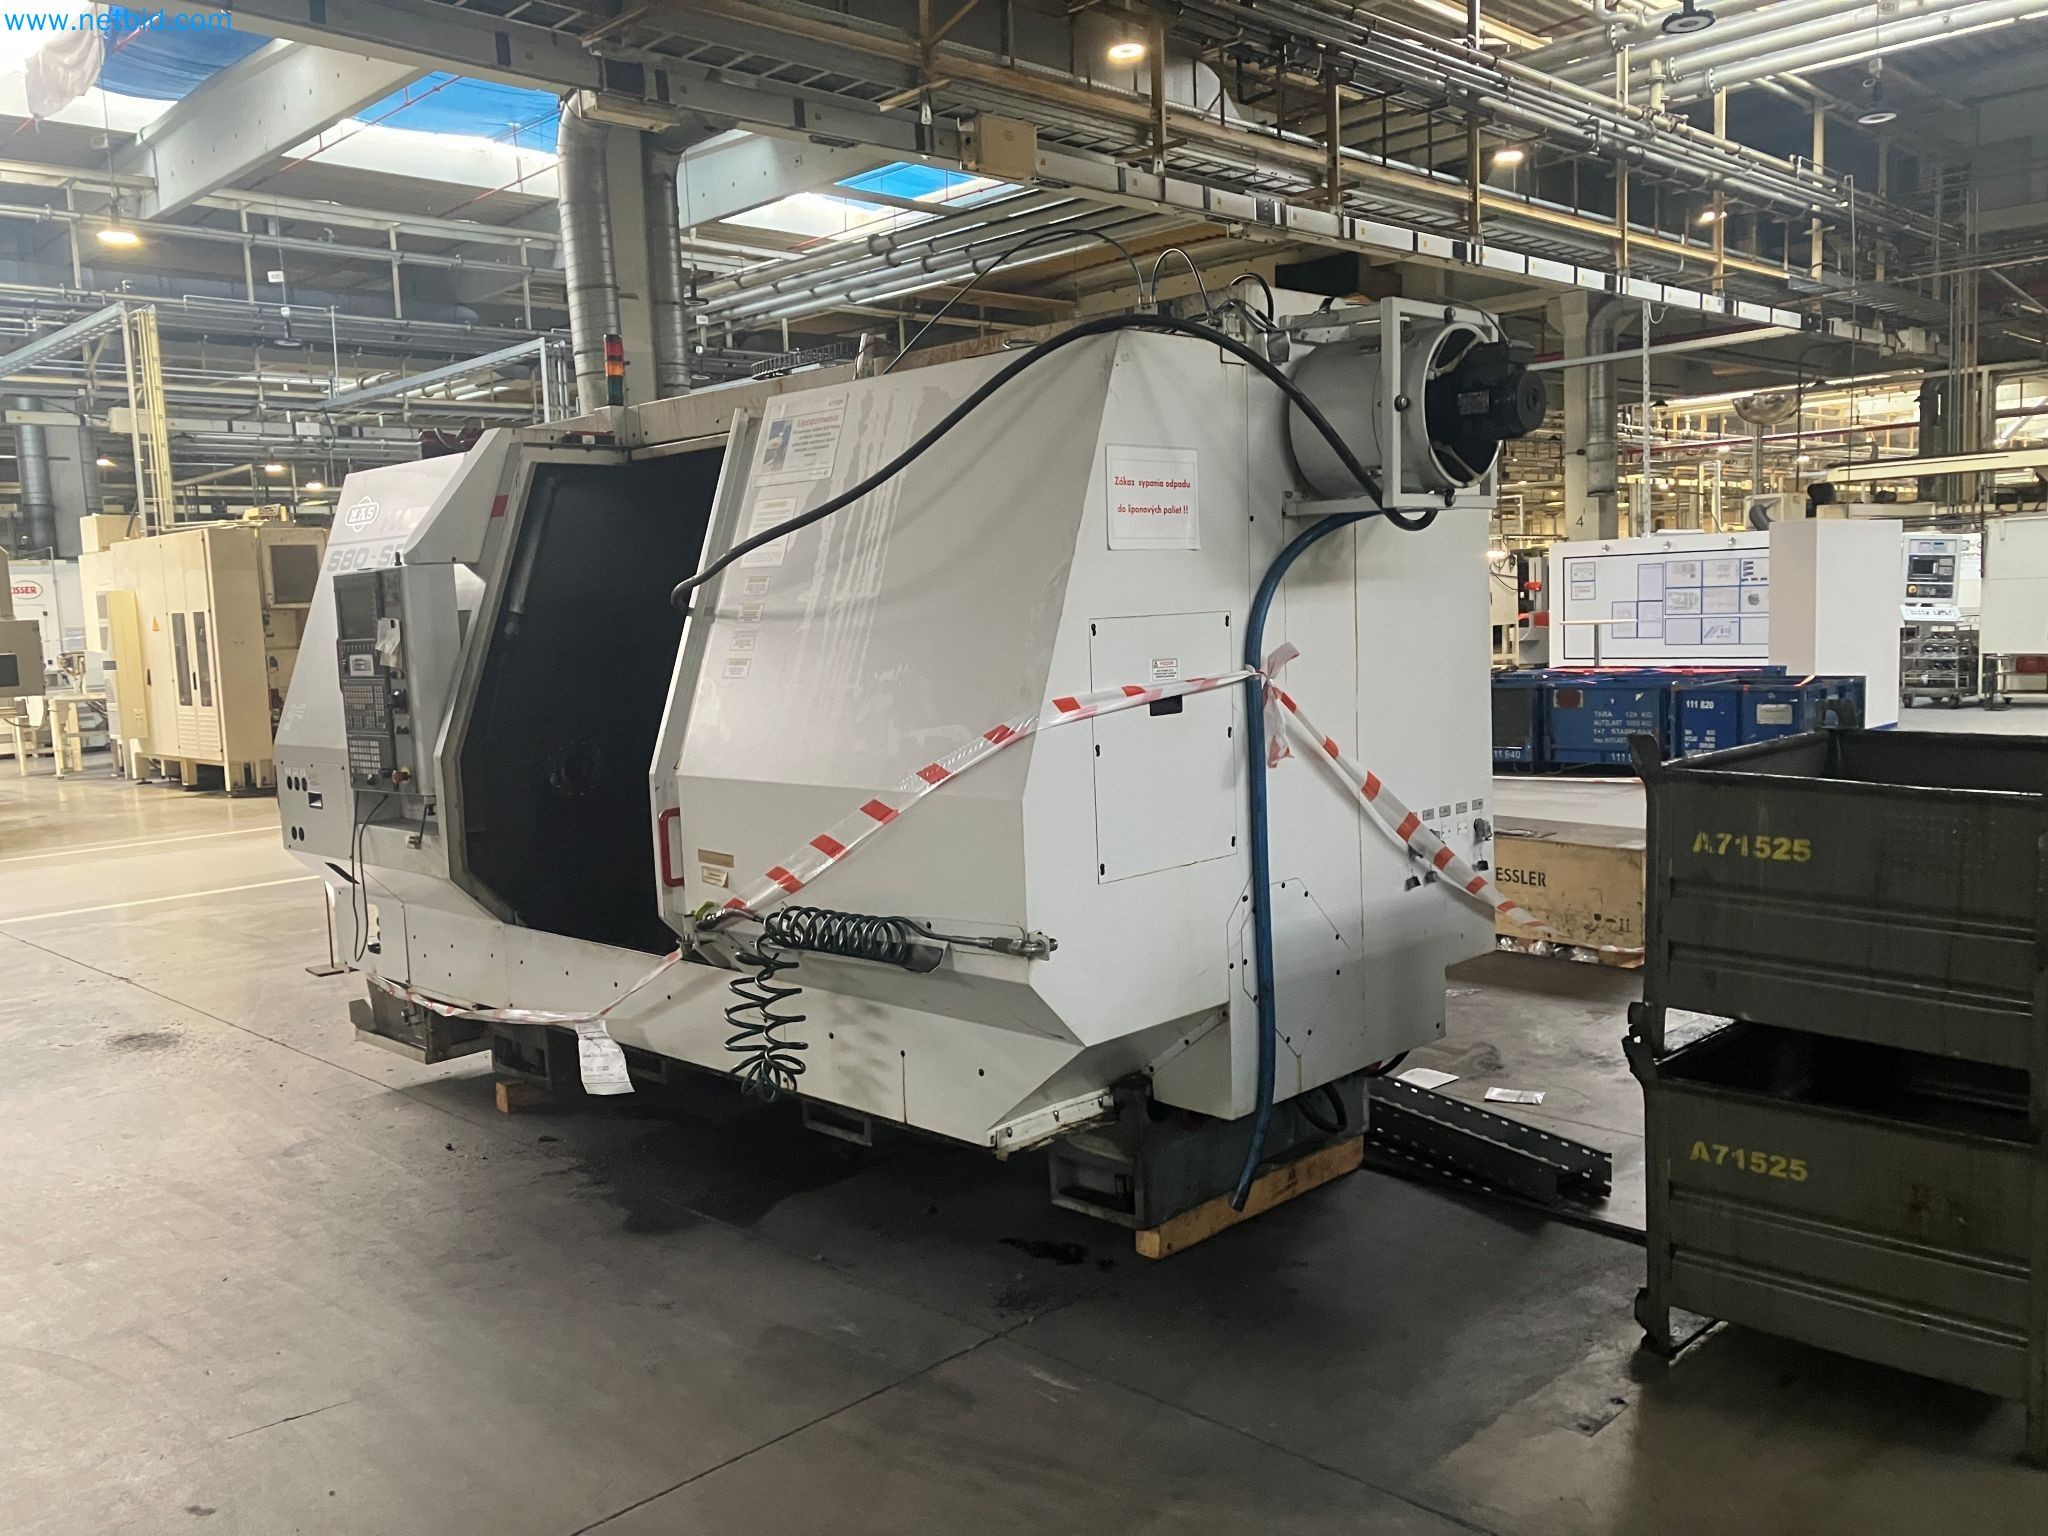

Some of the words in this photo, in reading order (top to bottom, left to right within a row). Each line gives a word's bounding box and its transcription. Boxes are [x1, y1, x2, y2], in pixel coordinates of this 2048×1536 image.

[1165, 478, 1191, 490] odpadu
[1118, 504, 1126, 513] do
[1576, 515, 1584, 527] 4
[1691, 831, 1812, 863] A71525
[1495, 866, 1546, 888] ESSLER
[1690, 1140, 1808, 1181] A71525
